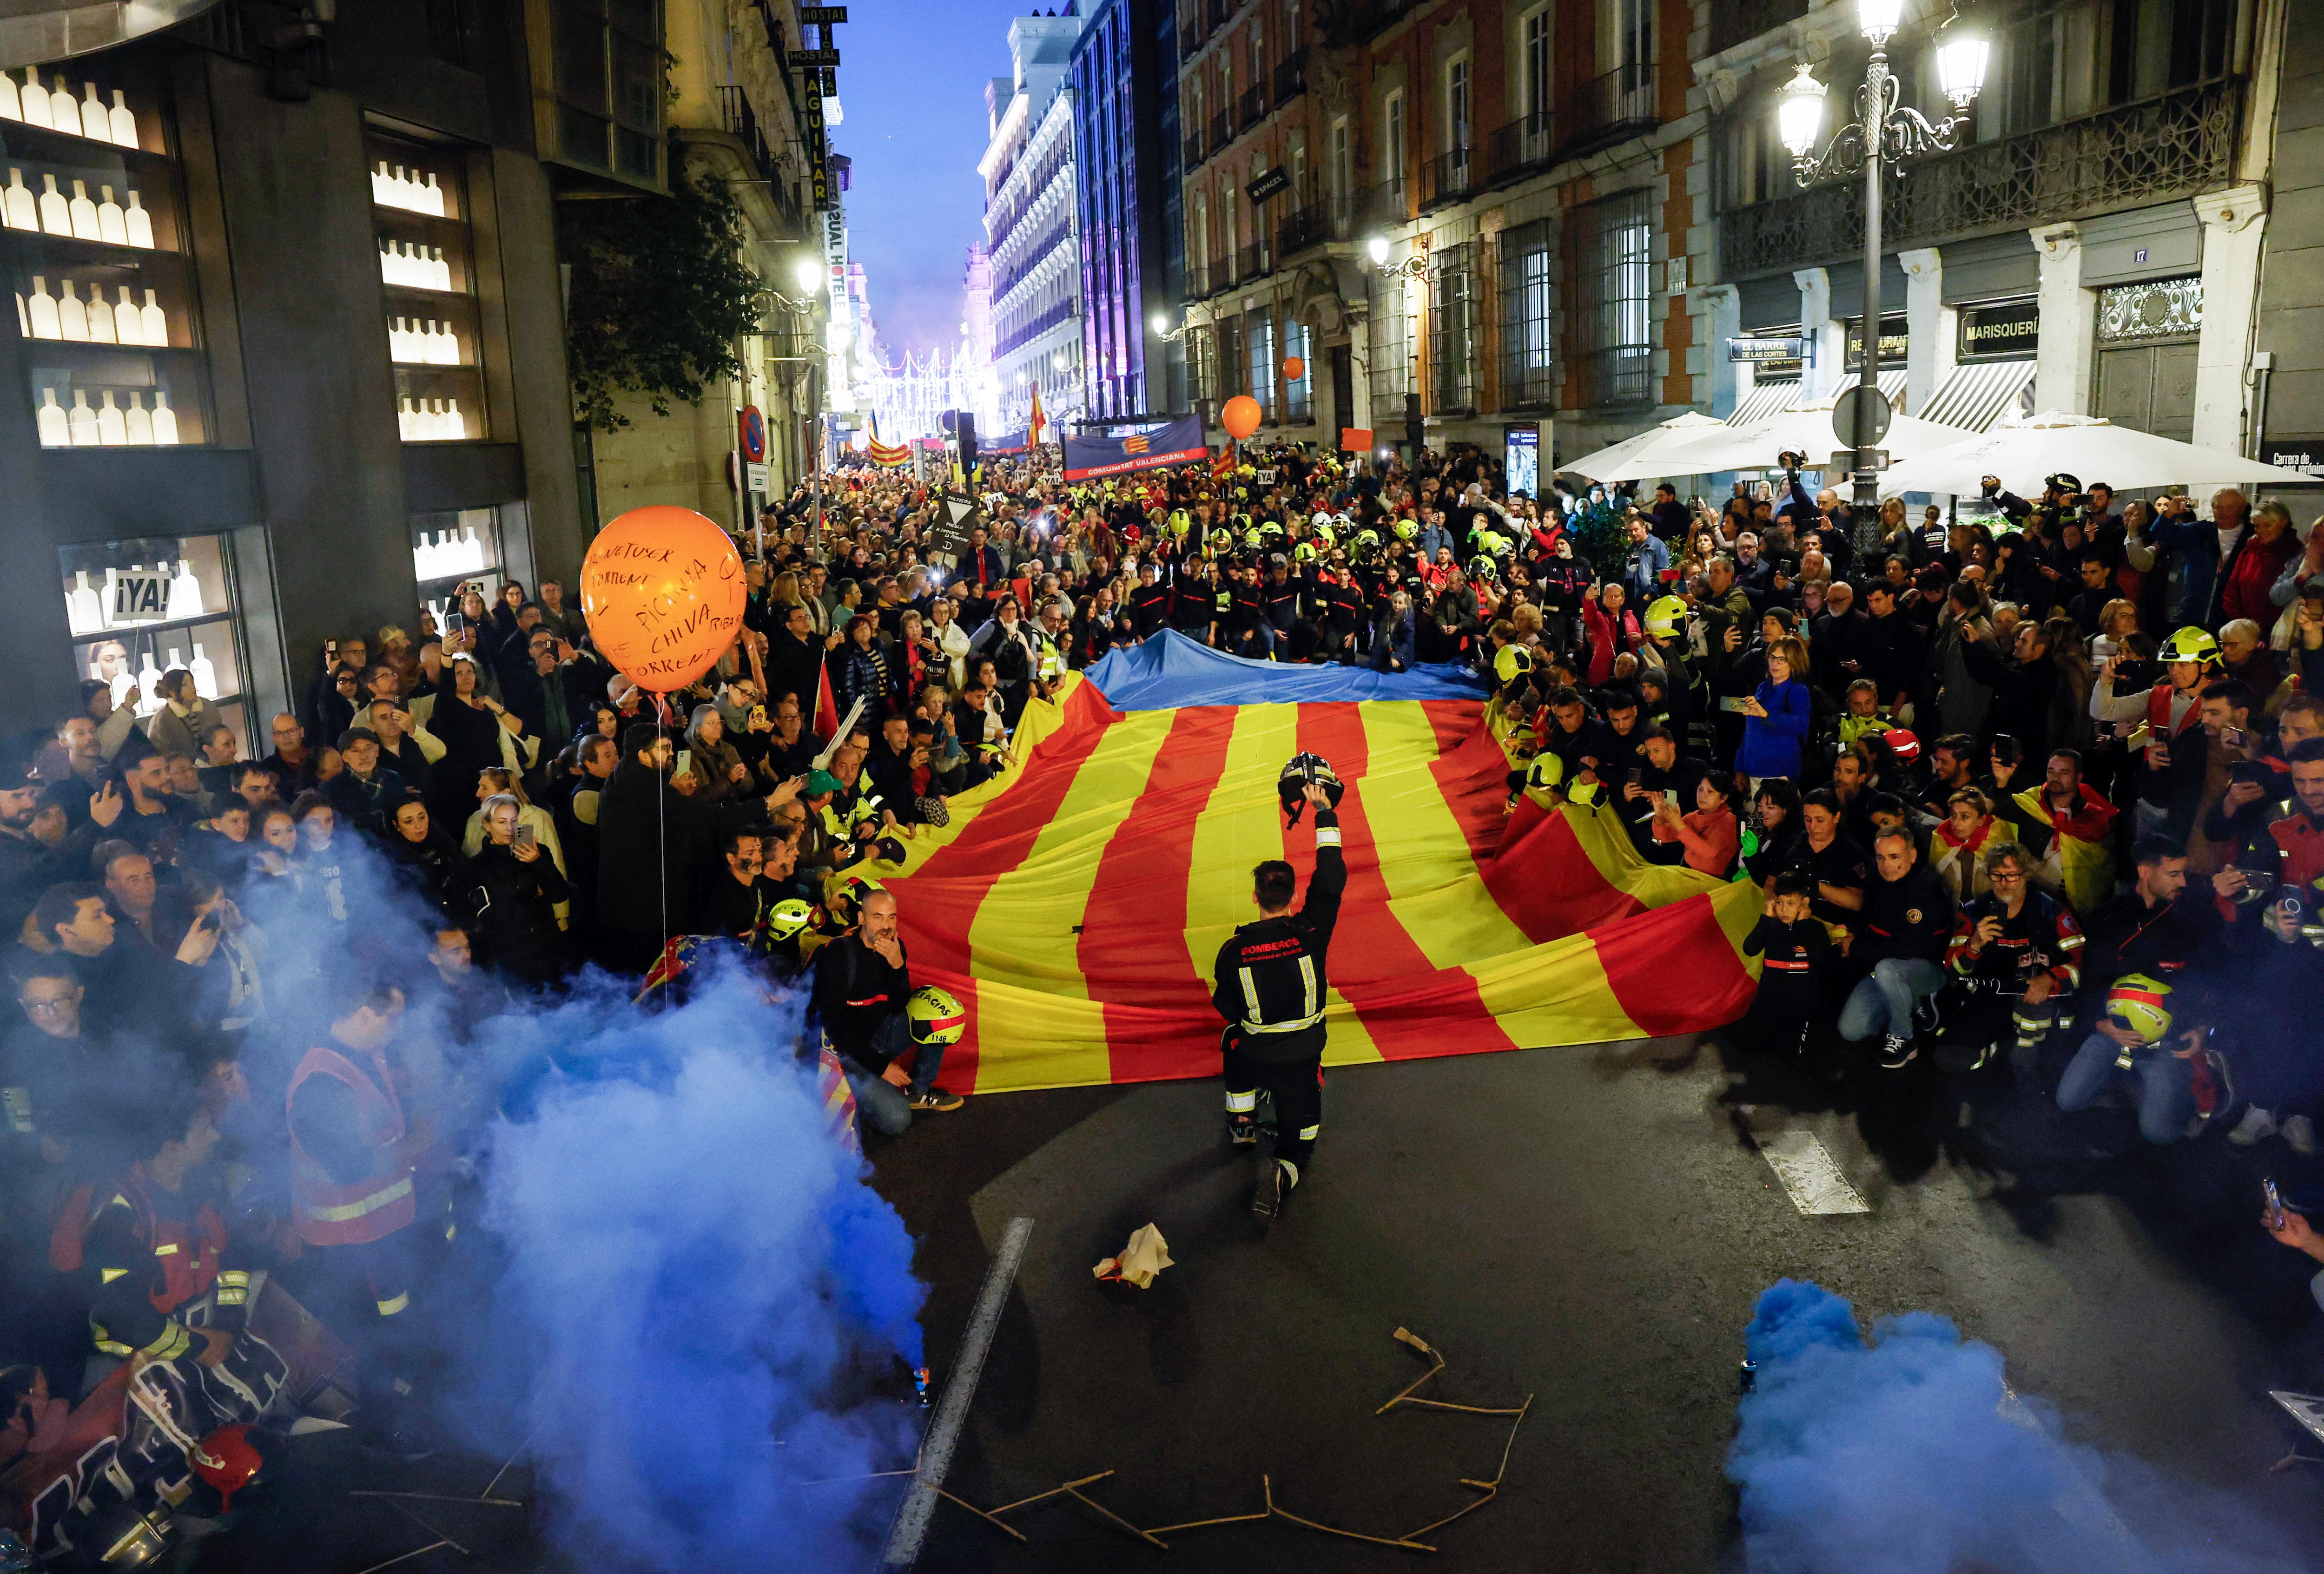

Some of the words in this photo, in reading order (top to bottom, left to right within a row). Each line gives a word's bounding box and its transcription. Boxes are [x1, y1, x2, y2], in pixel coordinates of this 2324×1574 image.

[803, 9, 845, 20] HOSTAL
[791, 51, 838, 60] HOSTAL
[807, 79, 825, 198] AGUILAR
[828, 201, 842, 250] ASUAL
[2136, 250, 2146, 262] 17
[1966, 316, 2039, 341] MARISQUERÍ
[1742, 342, 1754, 351] EL
[1755, 342, 1788, 350] BARRIL
[1088, 461, 1134, 475] COMUNITAT
[1136, 452, 1186, 467] VALENCIANA
[2273, 452, 2299, 465] Carrera
[2300, 452, 2310, 465] de
[1258, 472, 1275, 482] ¡YA!
[117, 579, 170, 612] ¡YA!
[652, 603, 710, 653] CHIVA
[621, 647, 716, 678] TORRENT
[1241, 937, 1300, 956] BOMBEROS
[1242, 954, 1274, 963] Comunidad
[1283, 947, 1303, 956] Madrid
[931, 1034, 947, 1043] 1146
